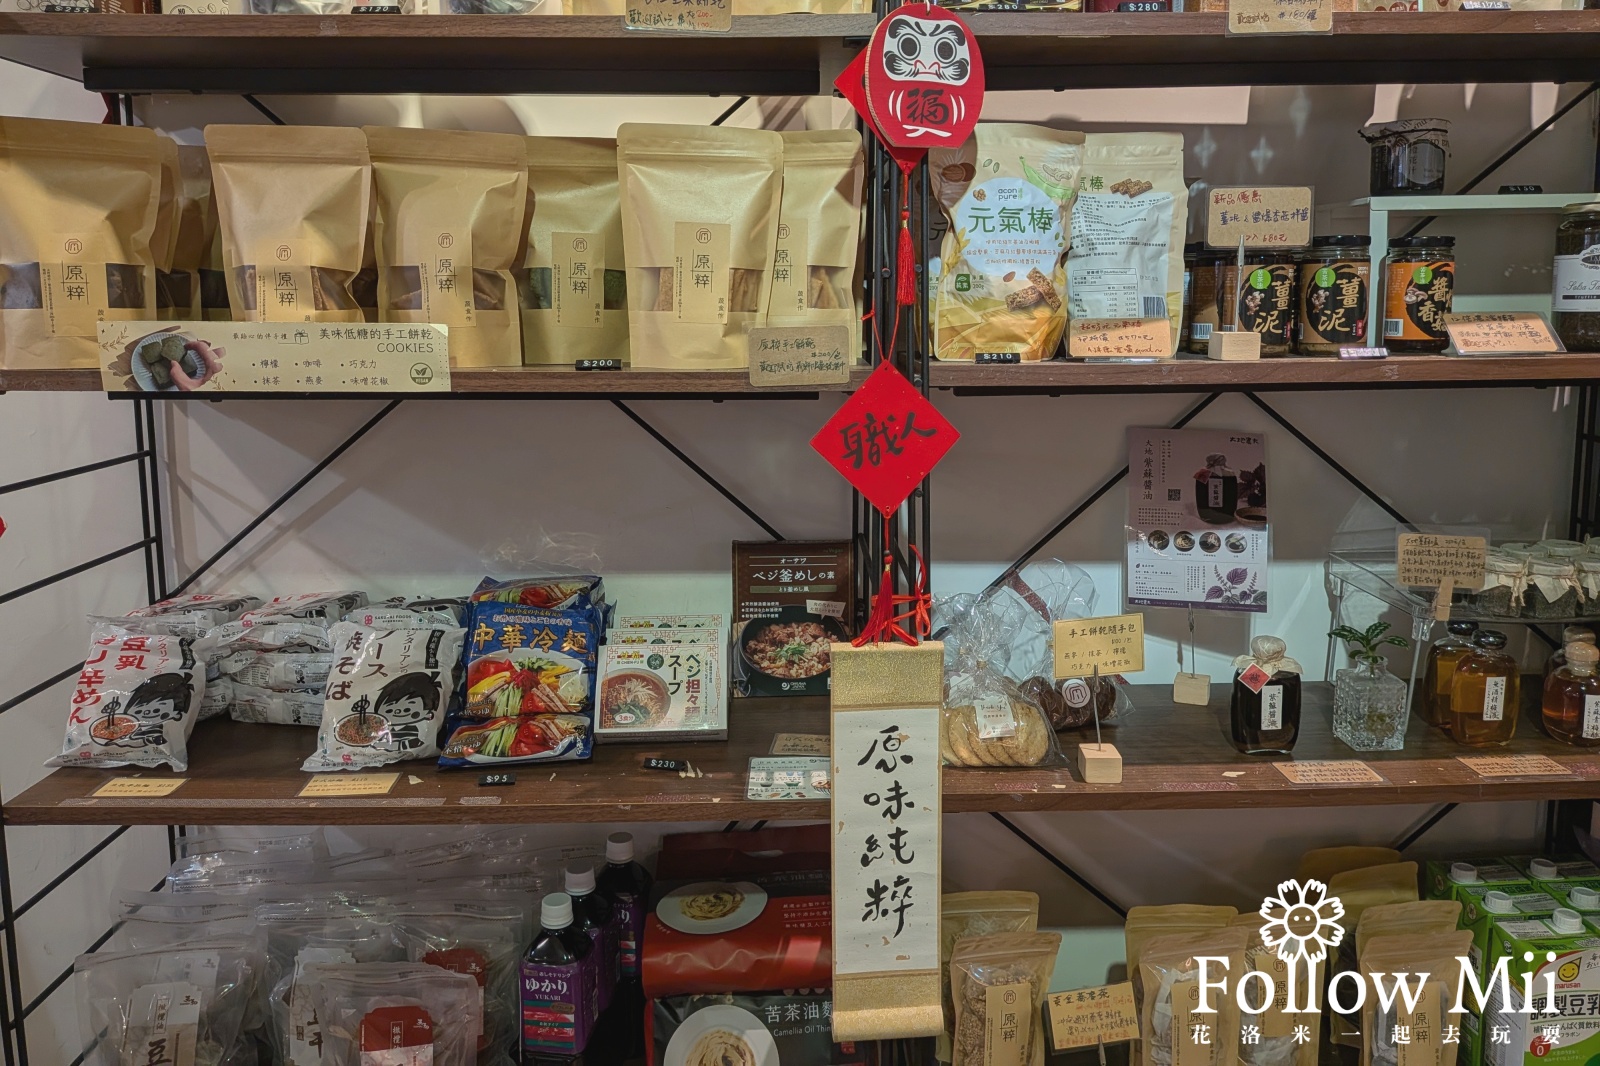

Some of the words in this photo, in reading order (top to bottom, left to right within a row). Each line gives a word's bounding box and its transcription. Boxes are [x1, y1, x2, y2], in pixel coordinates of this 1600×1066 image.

[906, 88, 949, 125] 福
[998, 194, 1018, 202] pure
[968, 206, 1054, 234] 元氣棒
[437, 259, 453, 292] 原粹
[572, 262, 588, 295] 原粹
[693, 254, 711, 289] 原粹
[774, 250, 790, 283] 原粹
[65, 265, 86, 300] 原粹
[277, 272, 295, 307] 原粹
[1253, 279, 1292, 334] 薑泥
[1318, 277, 1361, 332] 薑泥
[320, 328, 434, 340] 美味低糖的手工餅乾
[377, 343, 434, 353] COOKIES
[303, 359, 322, 368] 咖啡
[349, 359, 377, 369] 巧克力
[262, 376, 281, 386] 抹茶
[840, 412, 937, 470] 職人
[1143, 440, 1154, 500] 大地紫蘇醬油
[752, 568, 835, 583] ベジ釜めしの素
[1069, 623, 1136, 638] 手工餅乾隨手包
[114, 637, 152, 671] 豆乳
[668, 655, 684, 695] スープ
[618, 713, 634, 722] 3食分
[857, 725, 915, 939] 原味純粹
[525, 978, 568, 995] ゆかり
[1274, 981, 1288, 1009] 原粹
[1555, 982, 1581, 990] marusan
[774, 1028, 803, 1037] Camellia
[804, 1025, 816, 1034] Oil
[1003, 1013, 1016, 1042] 原粹
[1414, 1012, 1428, 1042] 原粹
